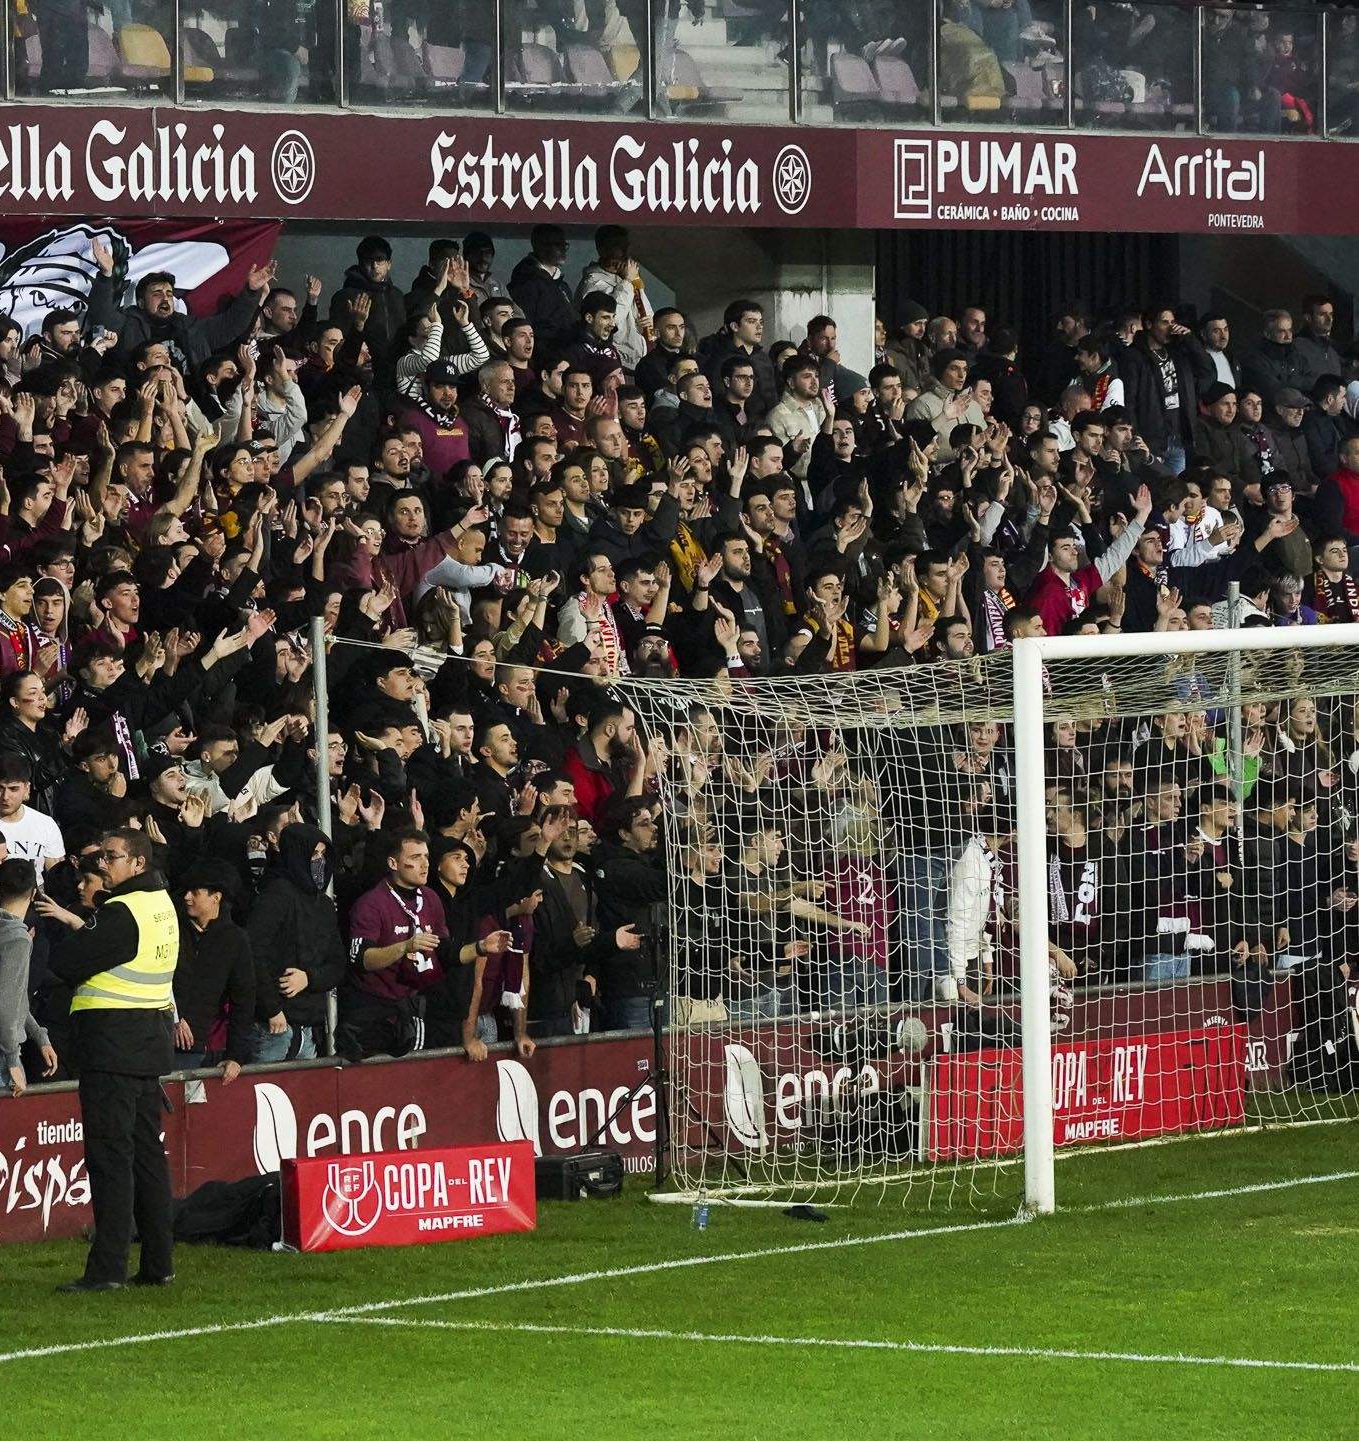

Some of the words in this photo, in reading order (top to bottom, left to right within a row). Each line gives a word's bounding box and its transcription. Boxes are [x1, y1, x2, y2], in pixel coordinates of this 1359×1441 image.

[85, 119, 258, 204] Galicia
[426, 130, 601, 213] Estrella
[610, 134, 762, 214] Galicia
[937, 140, 1079, 195] PUMAR
[1136, 143, 1265, 201] Arrital
[937, 203, 990, 220] CERÁMICA
[1001, 204, 1031, 221] BAÑO
[1040, 206, 1079, 221] COCINA
[1207, 213, 1265, 228] PONTEVEDRA
[857, 873, 876, 905] 2
[1052, 1050, 1087, 1111] OPA
[1092, 1096, 1108, 1106] DEL
[1113, 1043, 1148, 1103] REY
[37, 1117, 84, 1146] tienda
[306, 1103, 427, 1158] ence
[548, 1084, 657, 1149] ence
[1064, 1118, 1120, 1141] MAPFRE
[383, 1161, 449, 1211] COPA
[448, 1177, 468, 1187] DEL
[468, 1156, 512, 1205] REY
[418, 1213, 484, 1231] MAPFRE
